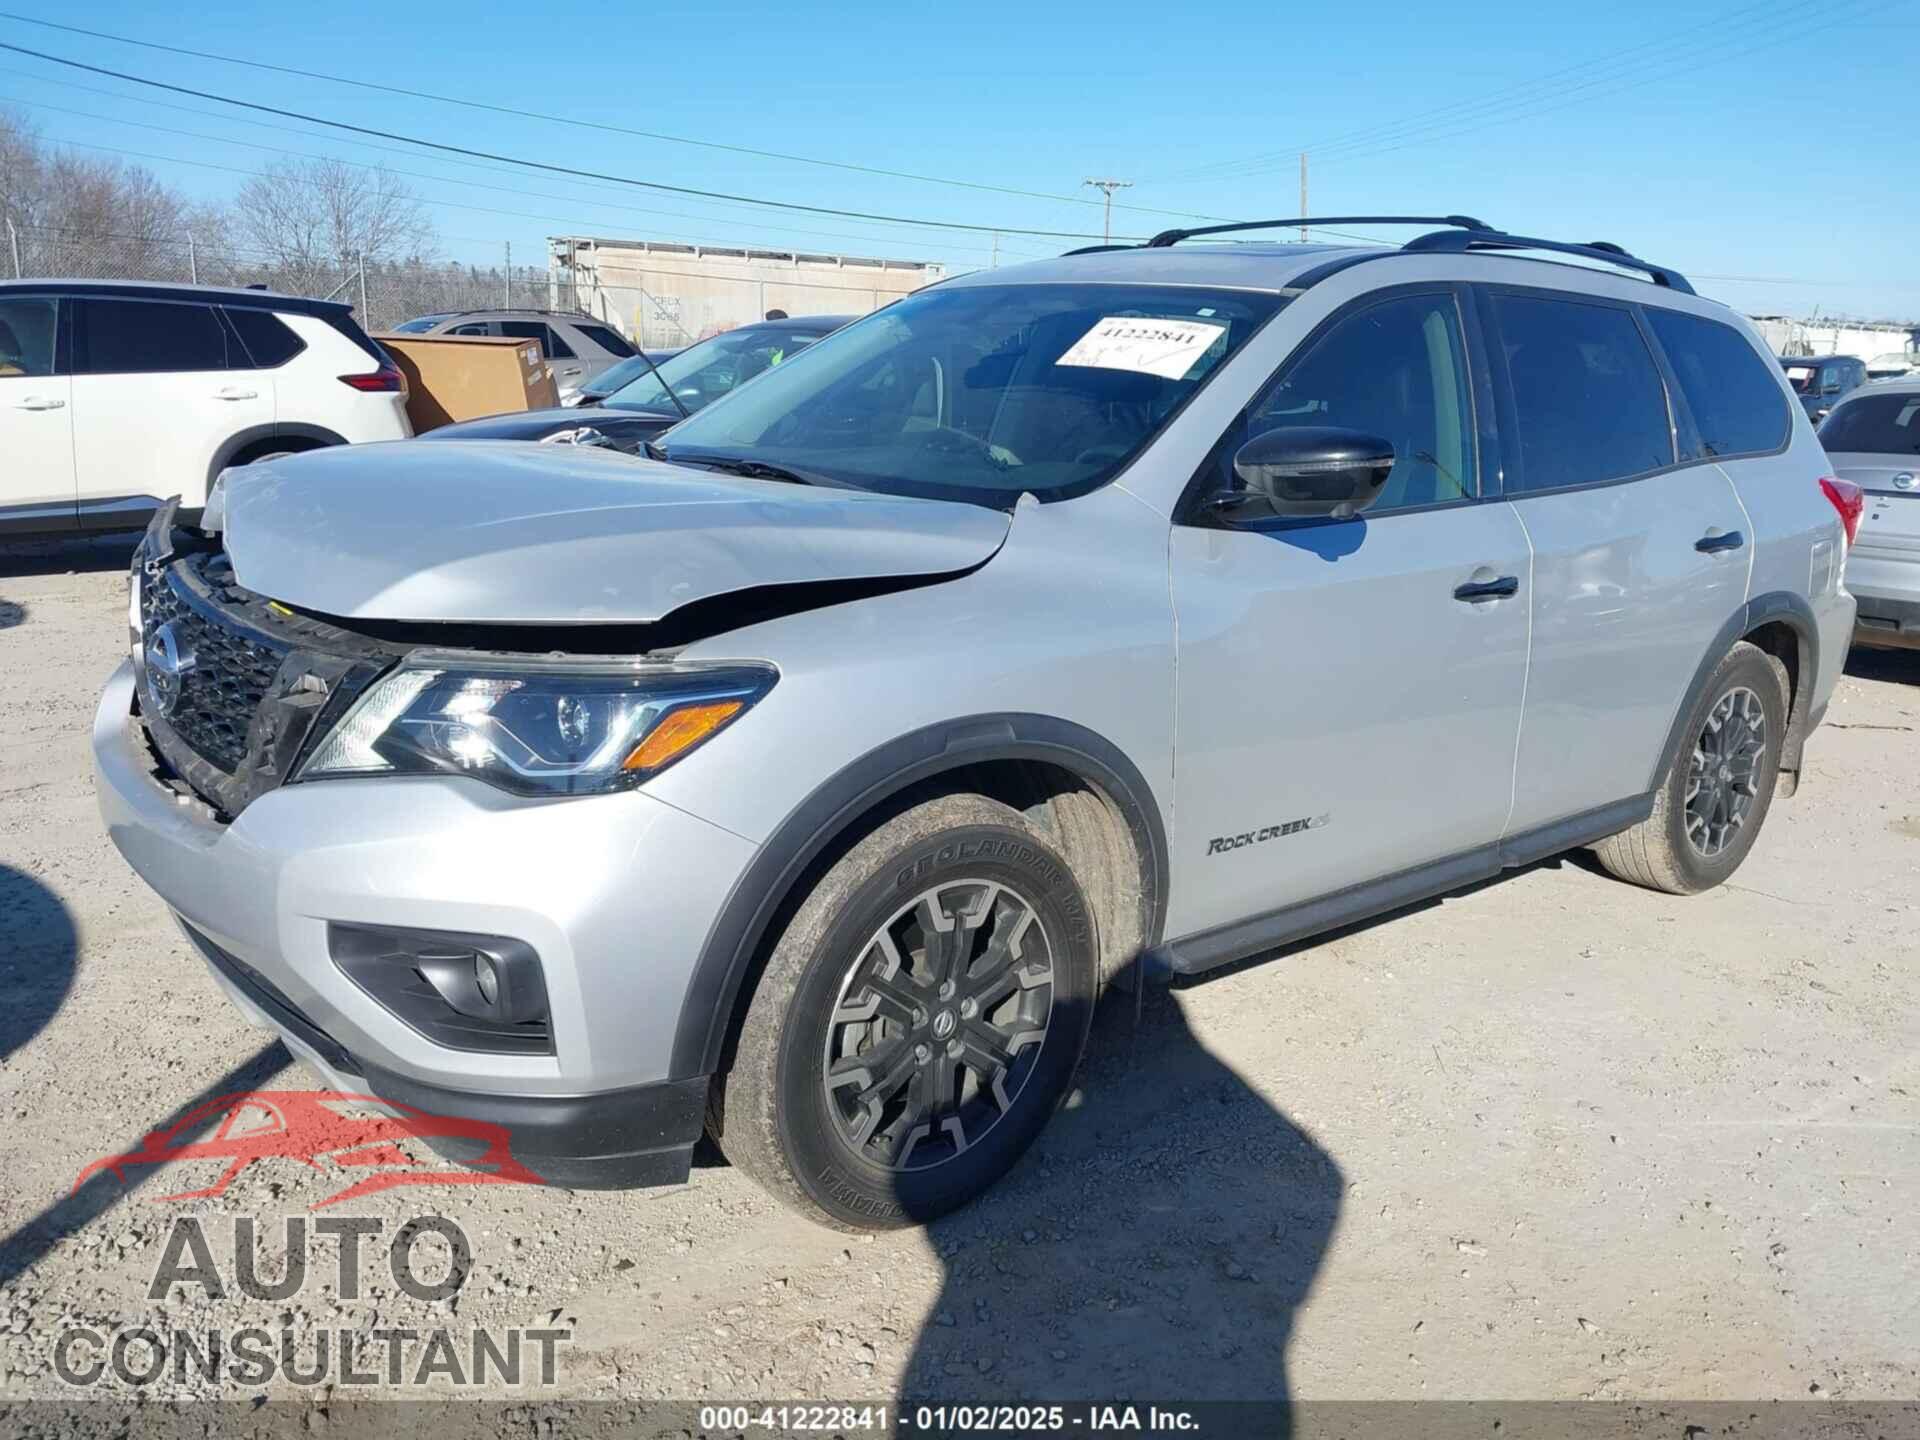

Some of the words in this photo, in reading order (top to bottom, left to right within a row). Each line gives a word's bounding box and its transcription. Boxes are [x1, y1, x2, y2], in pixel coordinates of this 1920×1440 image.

[1100, 327, 1195, 344] 41222841
[1207, 832, 1256, 856] ROCK
[1257, 817, 1312, 842] CREEK
